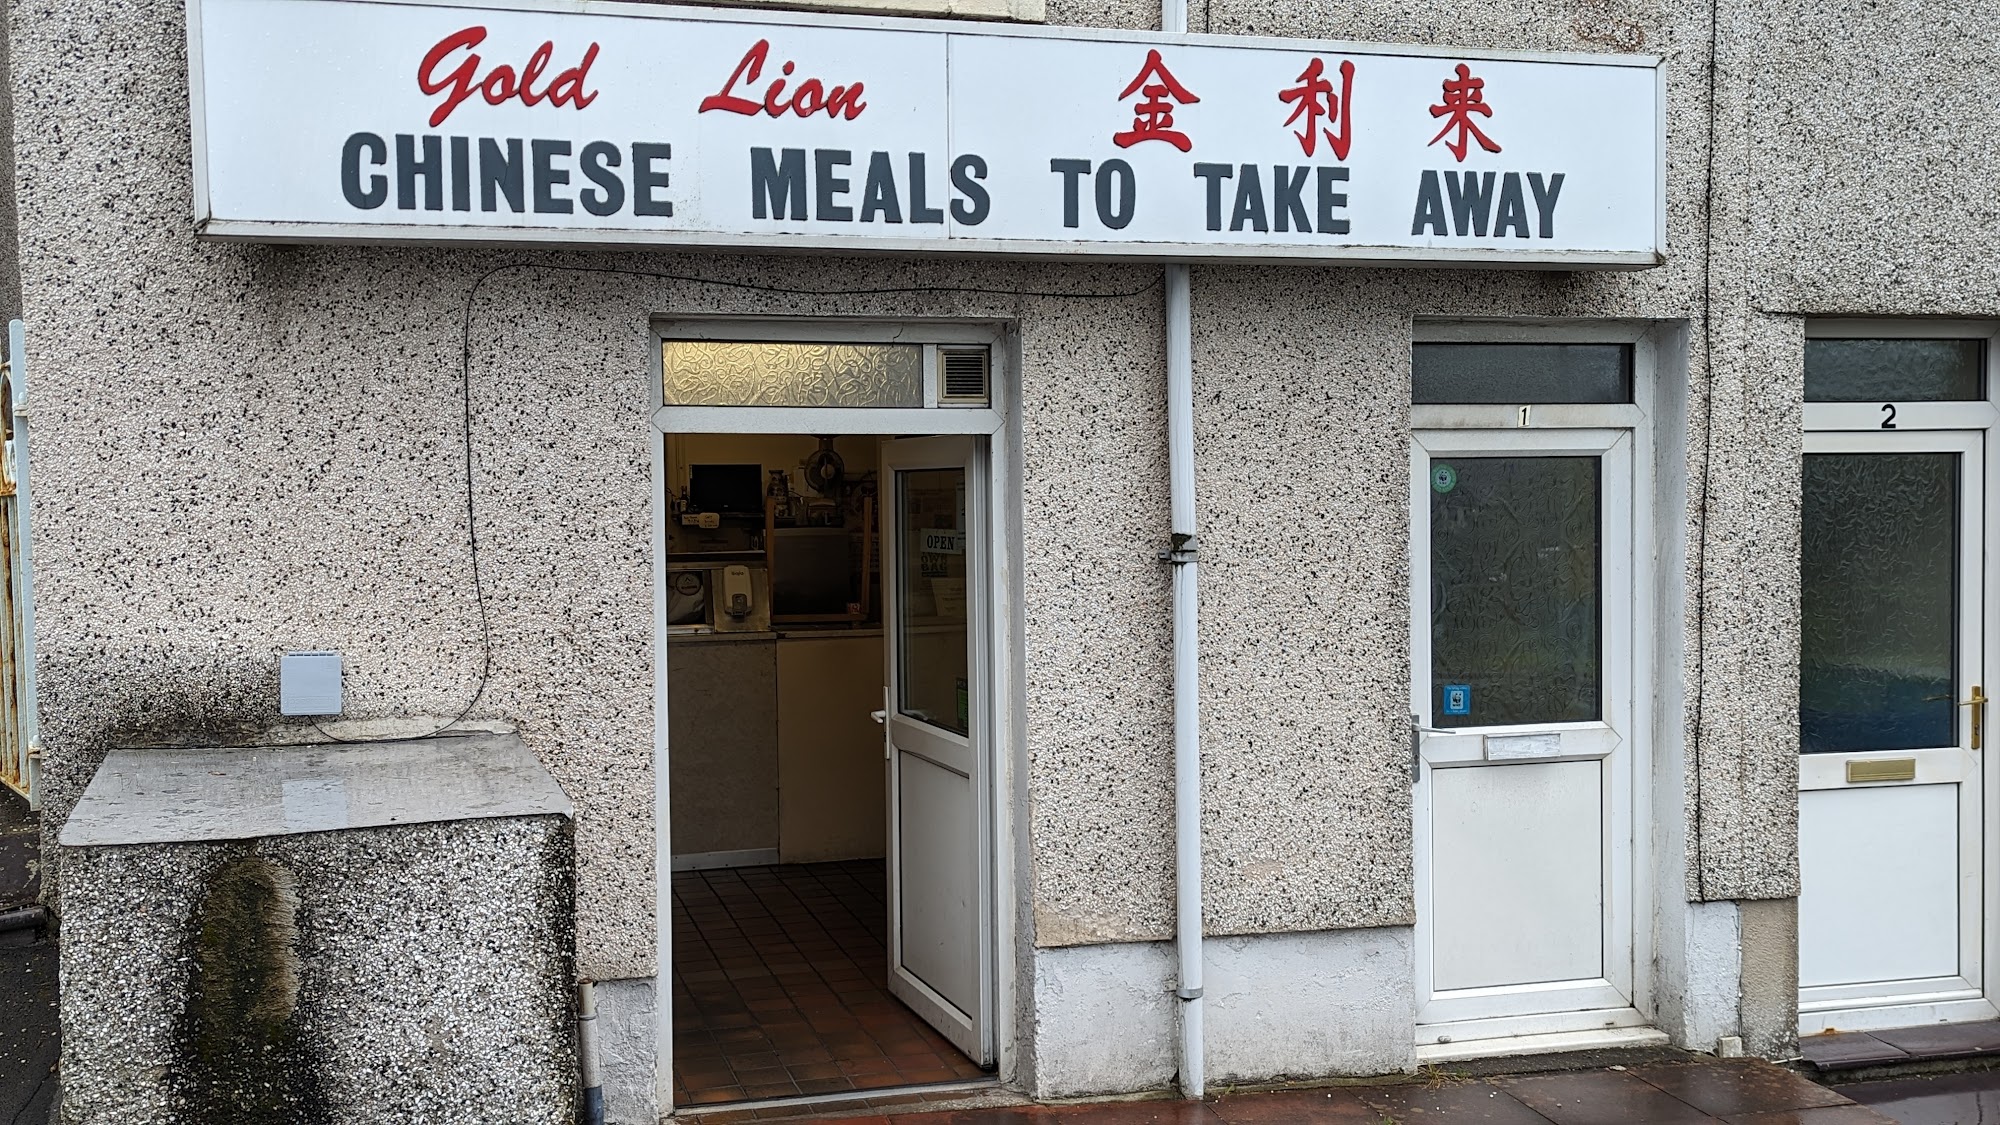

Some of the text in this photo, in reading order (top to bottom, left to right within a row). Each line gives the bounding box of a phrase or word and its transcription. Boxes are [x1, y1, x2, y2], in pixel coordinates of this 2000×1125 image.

[417, 25, 866, 127] Gold Lion
[341, 132, 1565, 239] CHINESE MEALS TO TAKE AWAY
[1521, 407, 1528, 426] 1
[1881, 403, 1897, 429] 2
[927, 534, 955, 550] OPEN
